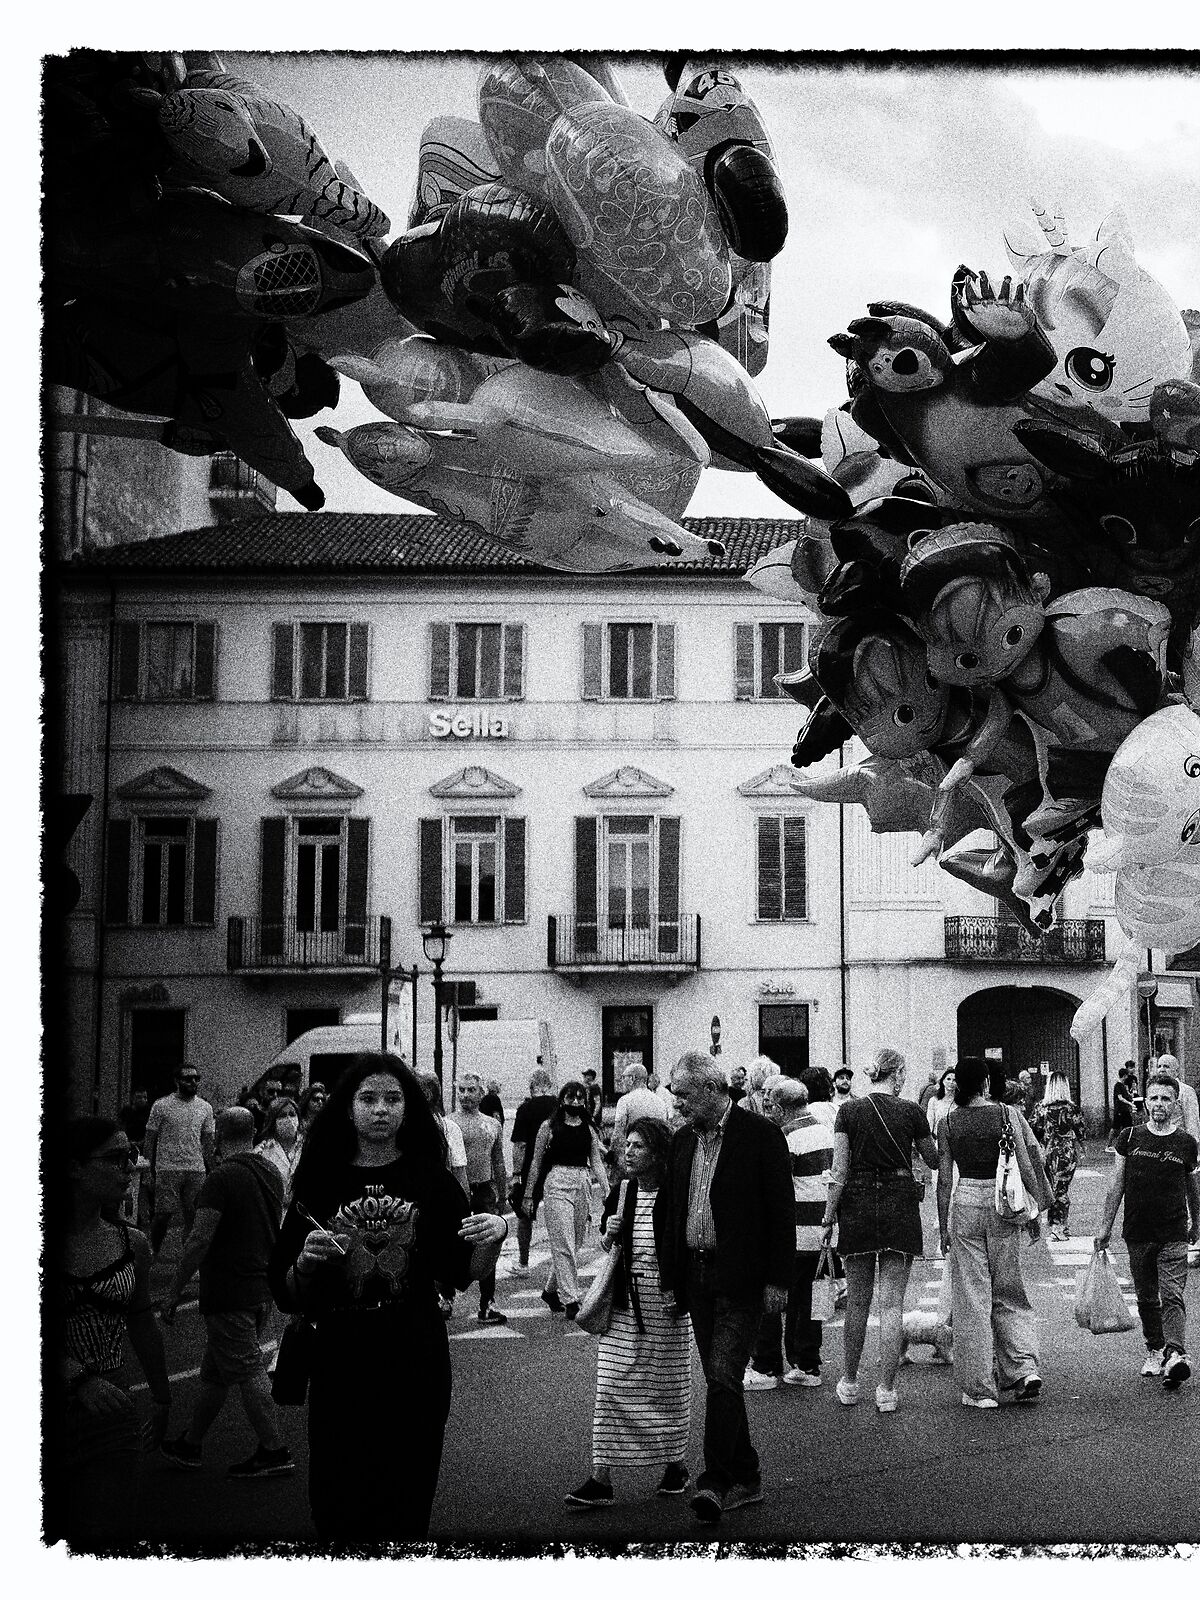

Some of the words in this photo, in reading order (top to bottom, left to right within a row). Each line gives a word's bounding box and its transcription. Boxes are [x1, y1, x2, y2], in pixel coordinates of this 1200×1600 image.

[429, 708, 509, 738] Sella
[365, 1184, 385, 1194] THE
[333, 1194, 415, 1229] UTOPIA
